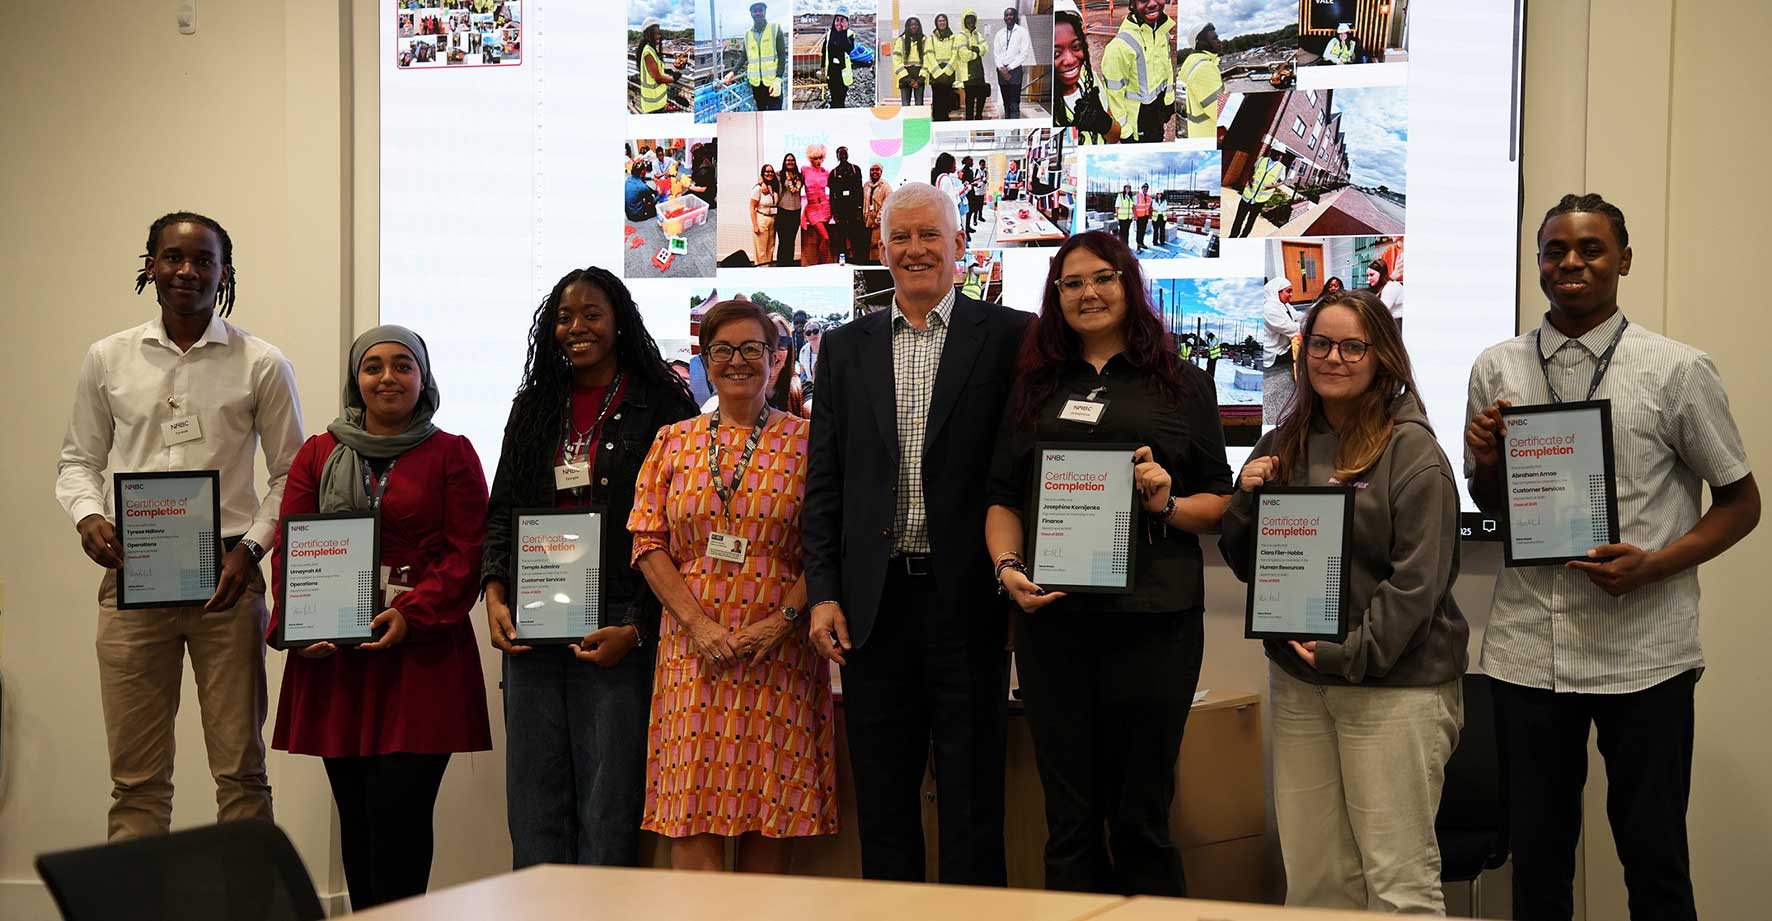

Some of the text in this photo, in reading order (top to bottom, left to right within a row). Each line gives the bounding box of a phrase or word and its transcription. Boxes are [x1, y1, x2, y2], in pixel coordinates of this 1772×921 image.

[1510, 433, 1576, 448] Certificate of
[1510, 445, 1574, 458] Completion
[1045, 471, 1108, 482] Certificate of
[1045, 481, 1104, 492] Completion
[126, 498, 188, 508] Certificate of
[126, 506, 186, 518] Completion
[1262, 516, 1320, 526] Certificate of
[1262, 526, 1317, 538] Completion
[290, 538, 350, 549] Certificate of
[522, 542, 576, 554] Completion
[290, 546, 347, 558] Completion
